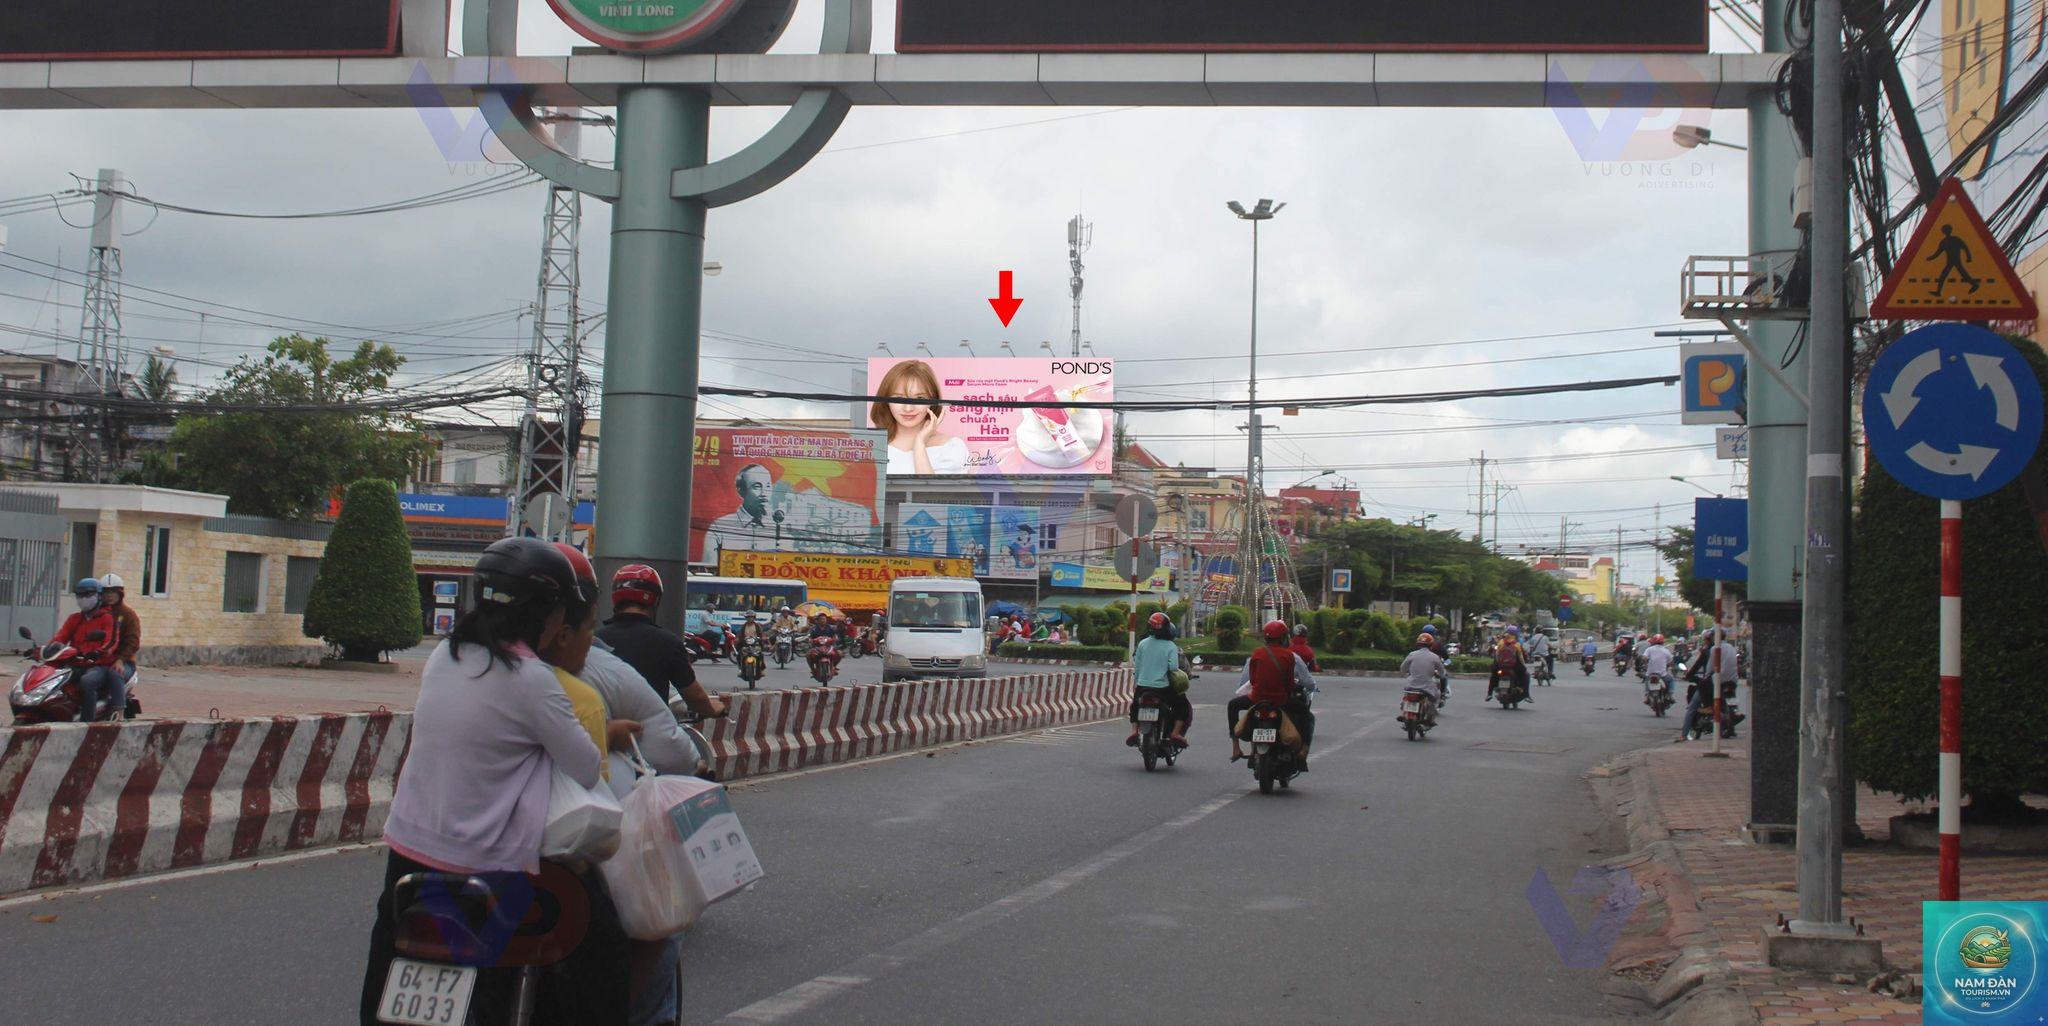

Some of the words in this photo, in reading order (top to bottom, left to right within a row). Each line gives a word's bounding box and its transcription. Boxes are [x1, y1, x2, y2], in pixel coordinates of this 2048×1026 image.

[637, 5, 674, 17] LONG
[1051, 362, 1112, 375] POND'S
[980, 425, 1010, 435] Hàn
[867, 438, 875, 448] 8
[835, 557, 880, 565] TRUNG
[760, 561, 831, 580] ĐỒNG
[399, 964, 463, 994] 64-F7
[391, 992, 454, 1024] 6033
